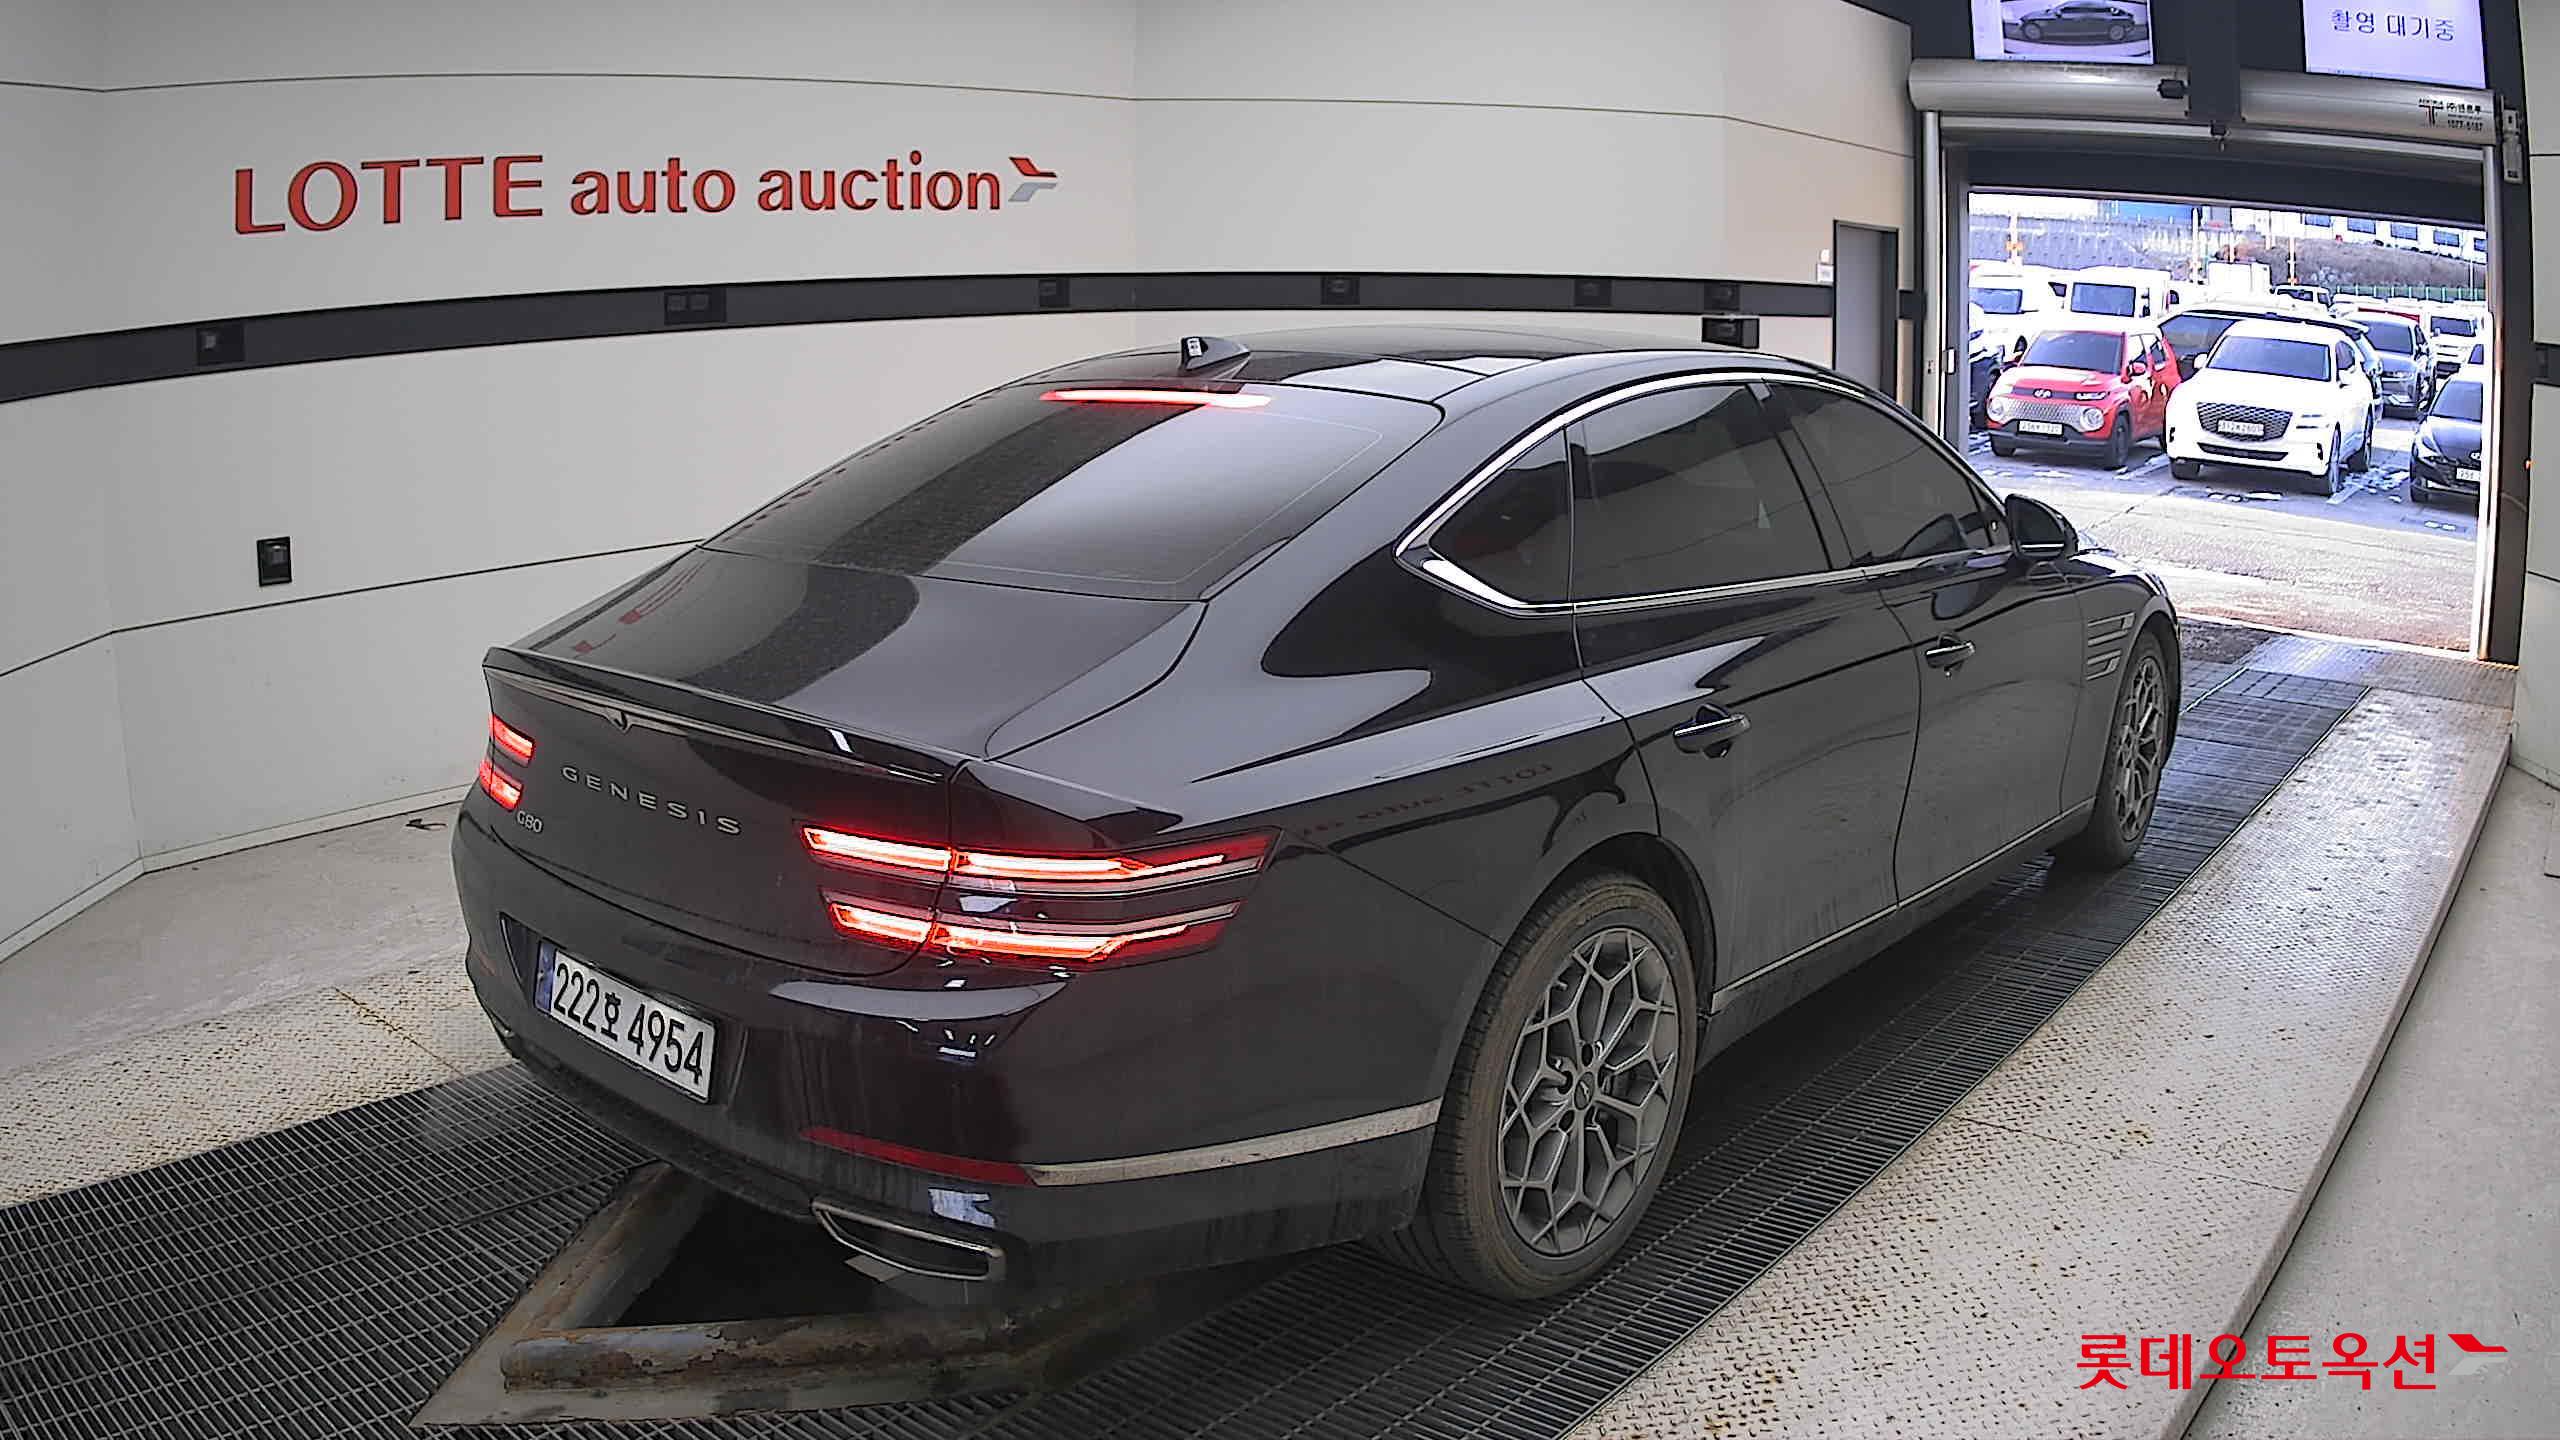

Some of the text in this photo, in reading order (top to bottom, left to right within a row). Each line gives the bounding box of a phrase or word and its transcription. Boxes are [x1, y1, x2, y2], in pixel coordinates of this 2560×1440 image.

[2331, 10, 2454, 42] 촬영 대기중
[235, 149, 1001, 235] LOTTE auto auction
[516, 810, 543, 833] G80
[562, 766, 741, 835] GENESIS
[553, 963, 704, 1085] 222호 4954
